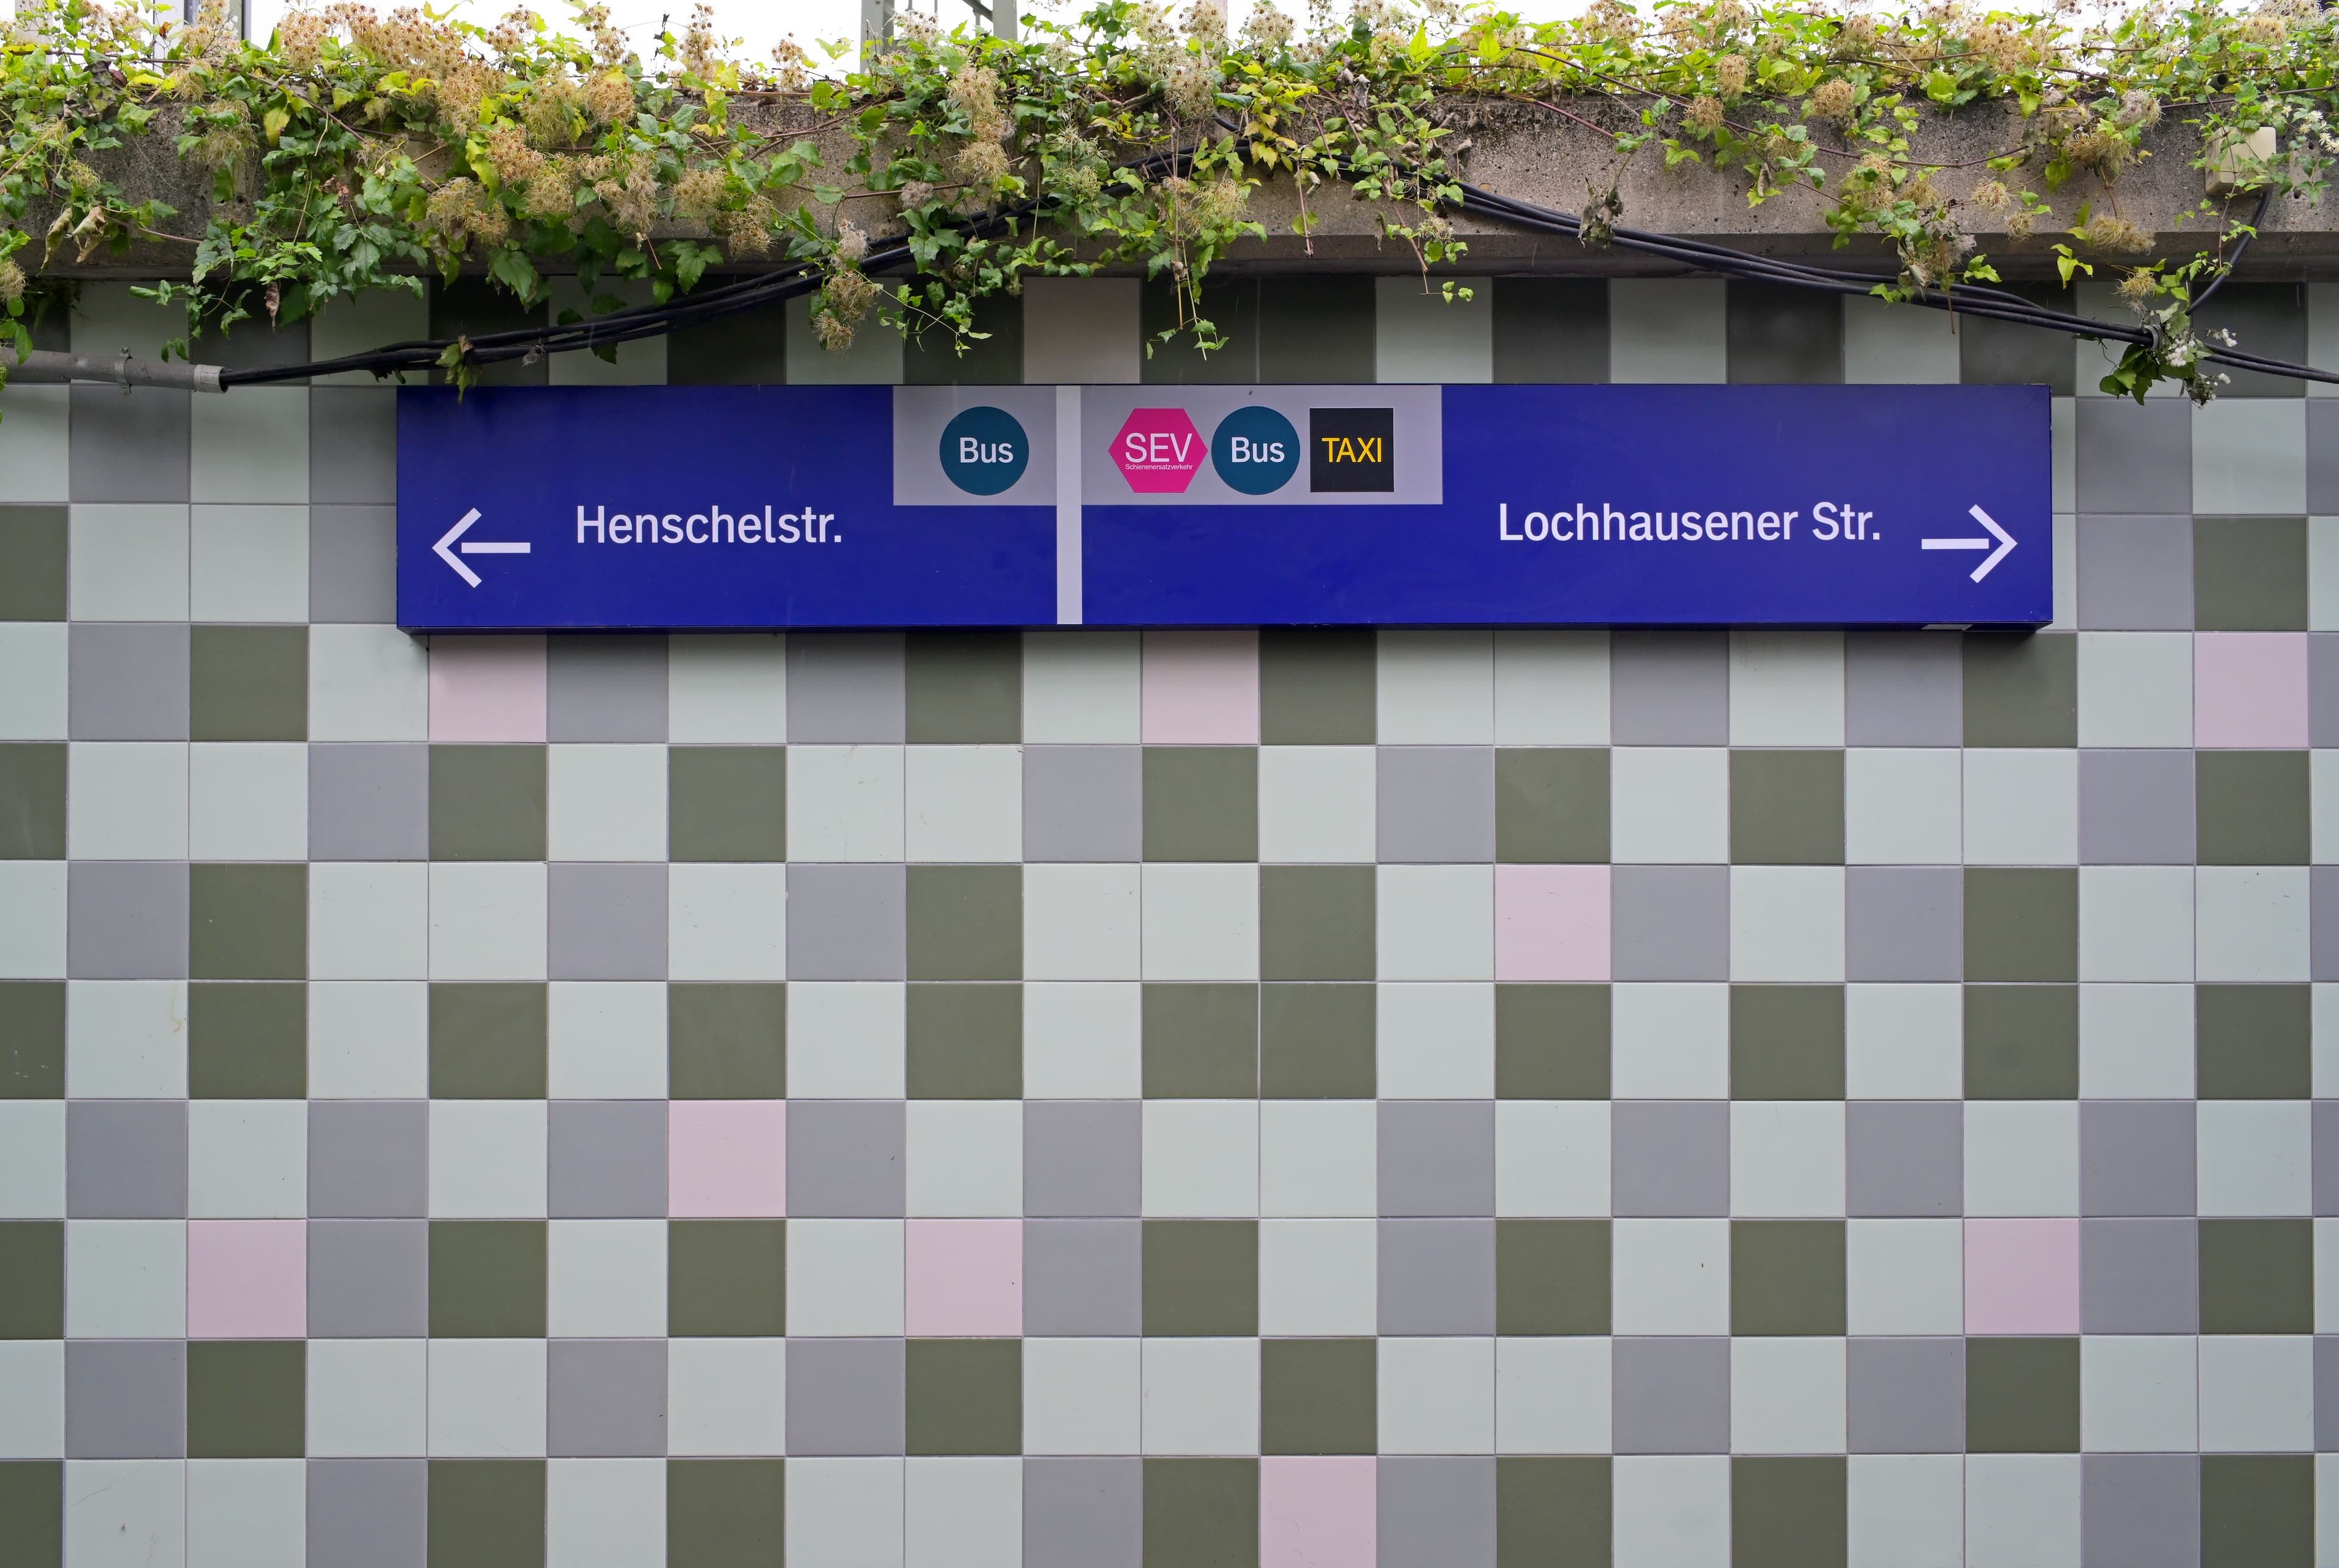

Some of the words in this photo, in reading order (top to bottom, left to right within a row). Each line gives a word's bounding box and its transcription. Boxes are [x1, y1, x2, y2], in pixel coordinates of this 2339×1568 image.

[960, 437, 1014, 463] Bus
[1126, 432, 1192, 462] SEV
[1232, 437, 1285, 463] Bus
[1321, 437, 1382, 463] TAXI
[577, 504, 842, 544] Henschelstr.
[1499, 502, 1799, 541] Lochhausener
[1812, 501, 1881, 541] Str.
